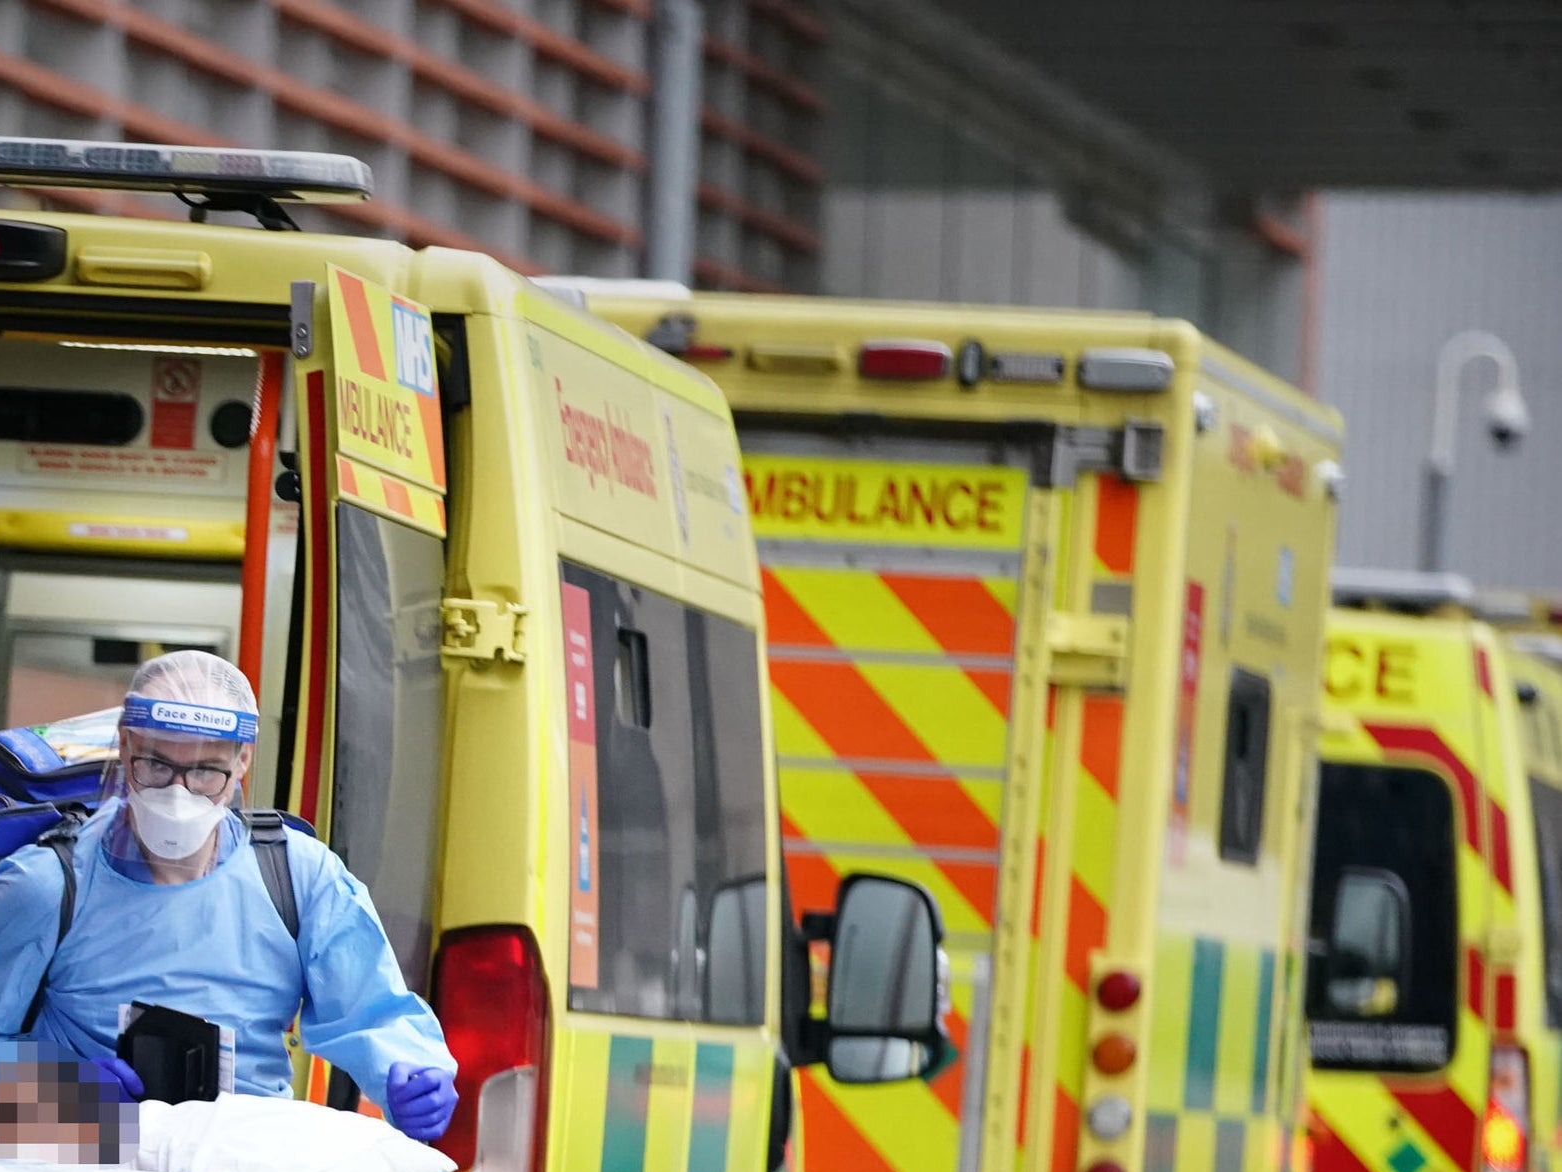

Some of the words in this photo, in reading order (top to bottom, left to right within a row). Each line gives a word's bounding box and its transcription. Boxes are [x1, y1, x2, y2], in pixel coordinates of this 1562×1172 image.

[394, 307, 435, 395] NHS
[338, 375, 412, 459] MBULANCE
[742, 468, 1006, 535] MBULANCE
[156, 706, 188, 721] Face
[193, 712, 231, 727] Shield
